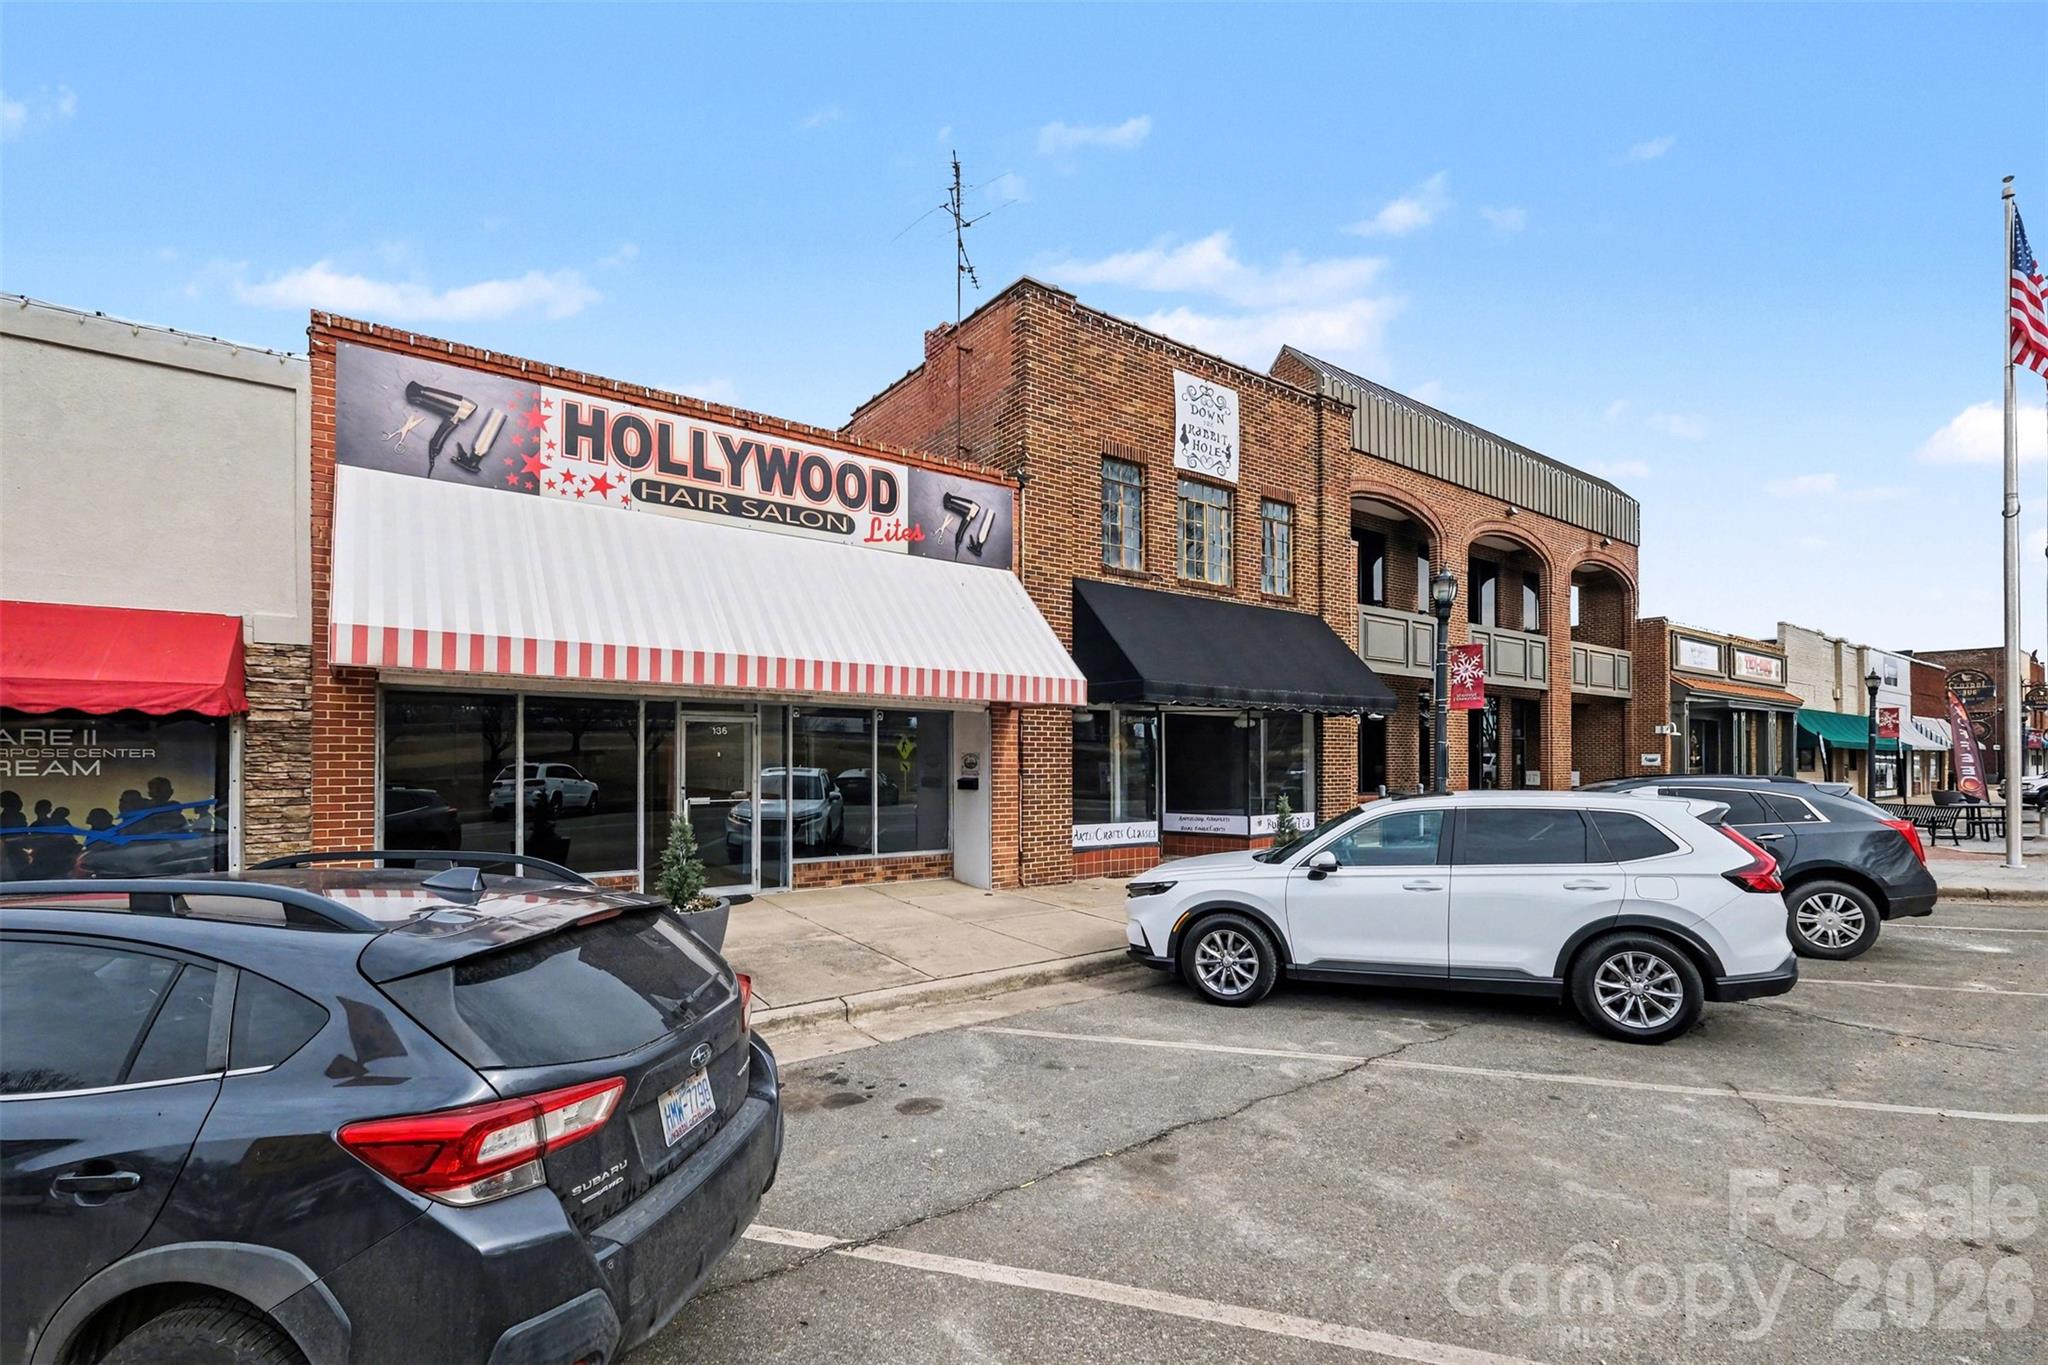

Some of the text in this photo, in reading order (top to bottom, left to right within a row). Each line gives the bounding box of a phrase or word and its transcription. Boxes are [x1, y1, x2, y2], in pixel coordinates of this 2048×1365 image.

[1190, 404, 1224, 425] DOWN
[561, 399, 900, 517] HOLLYWOOD
[1192, 439, 1222, 457] HOLE
[640, 481, 849, 534] HAIR SALON
[864, 517, 926, 544] Lites
[83, 729, 97, 746] II
[712, 727, 728, 735] 136
[74, 748, 156, 758] CENTER
[571, 1160, 628, 1197] SUBARU
